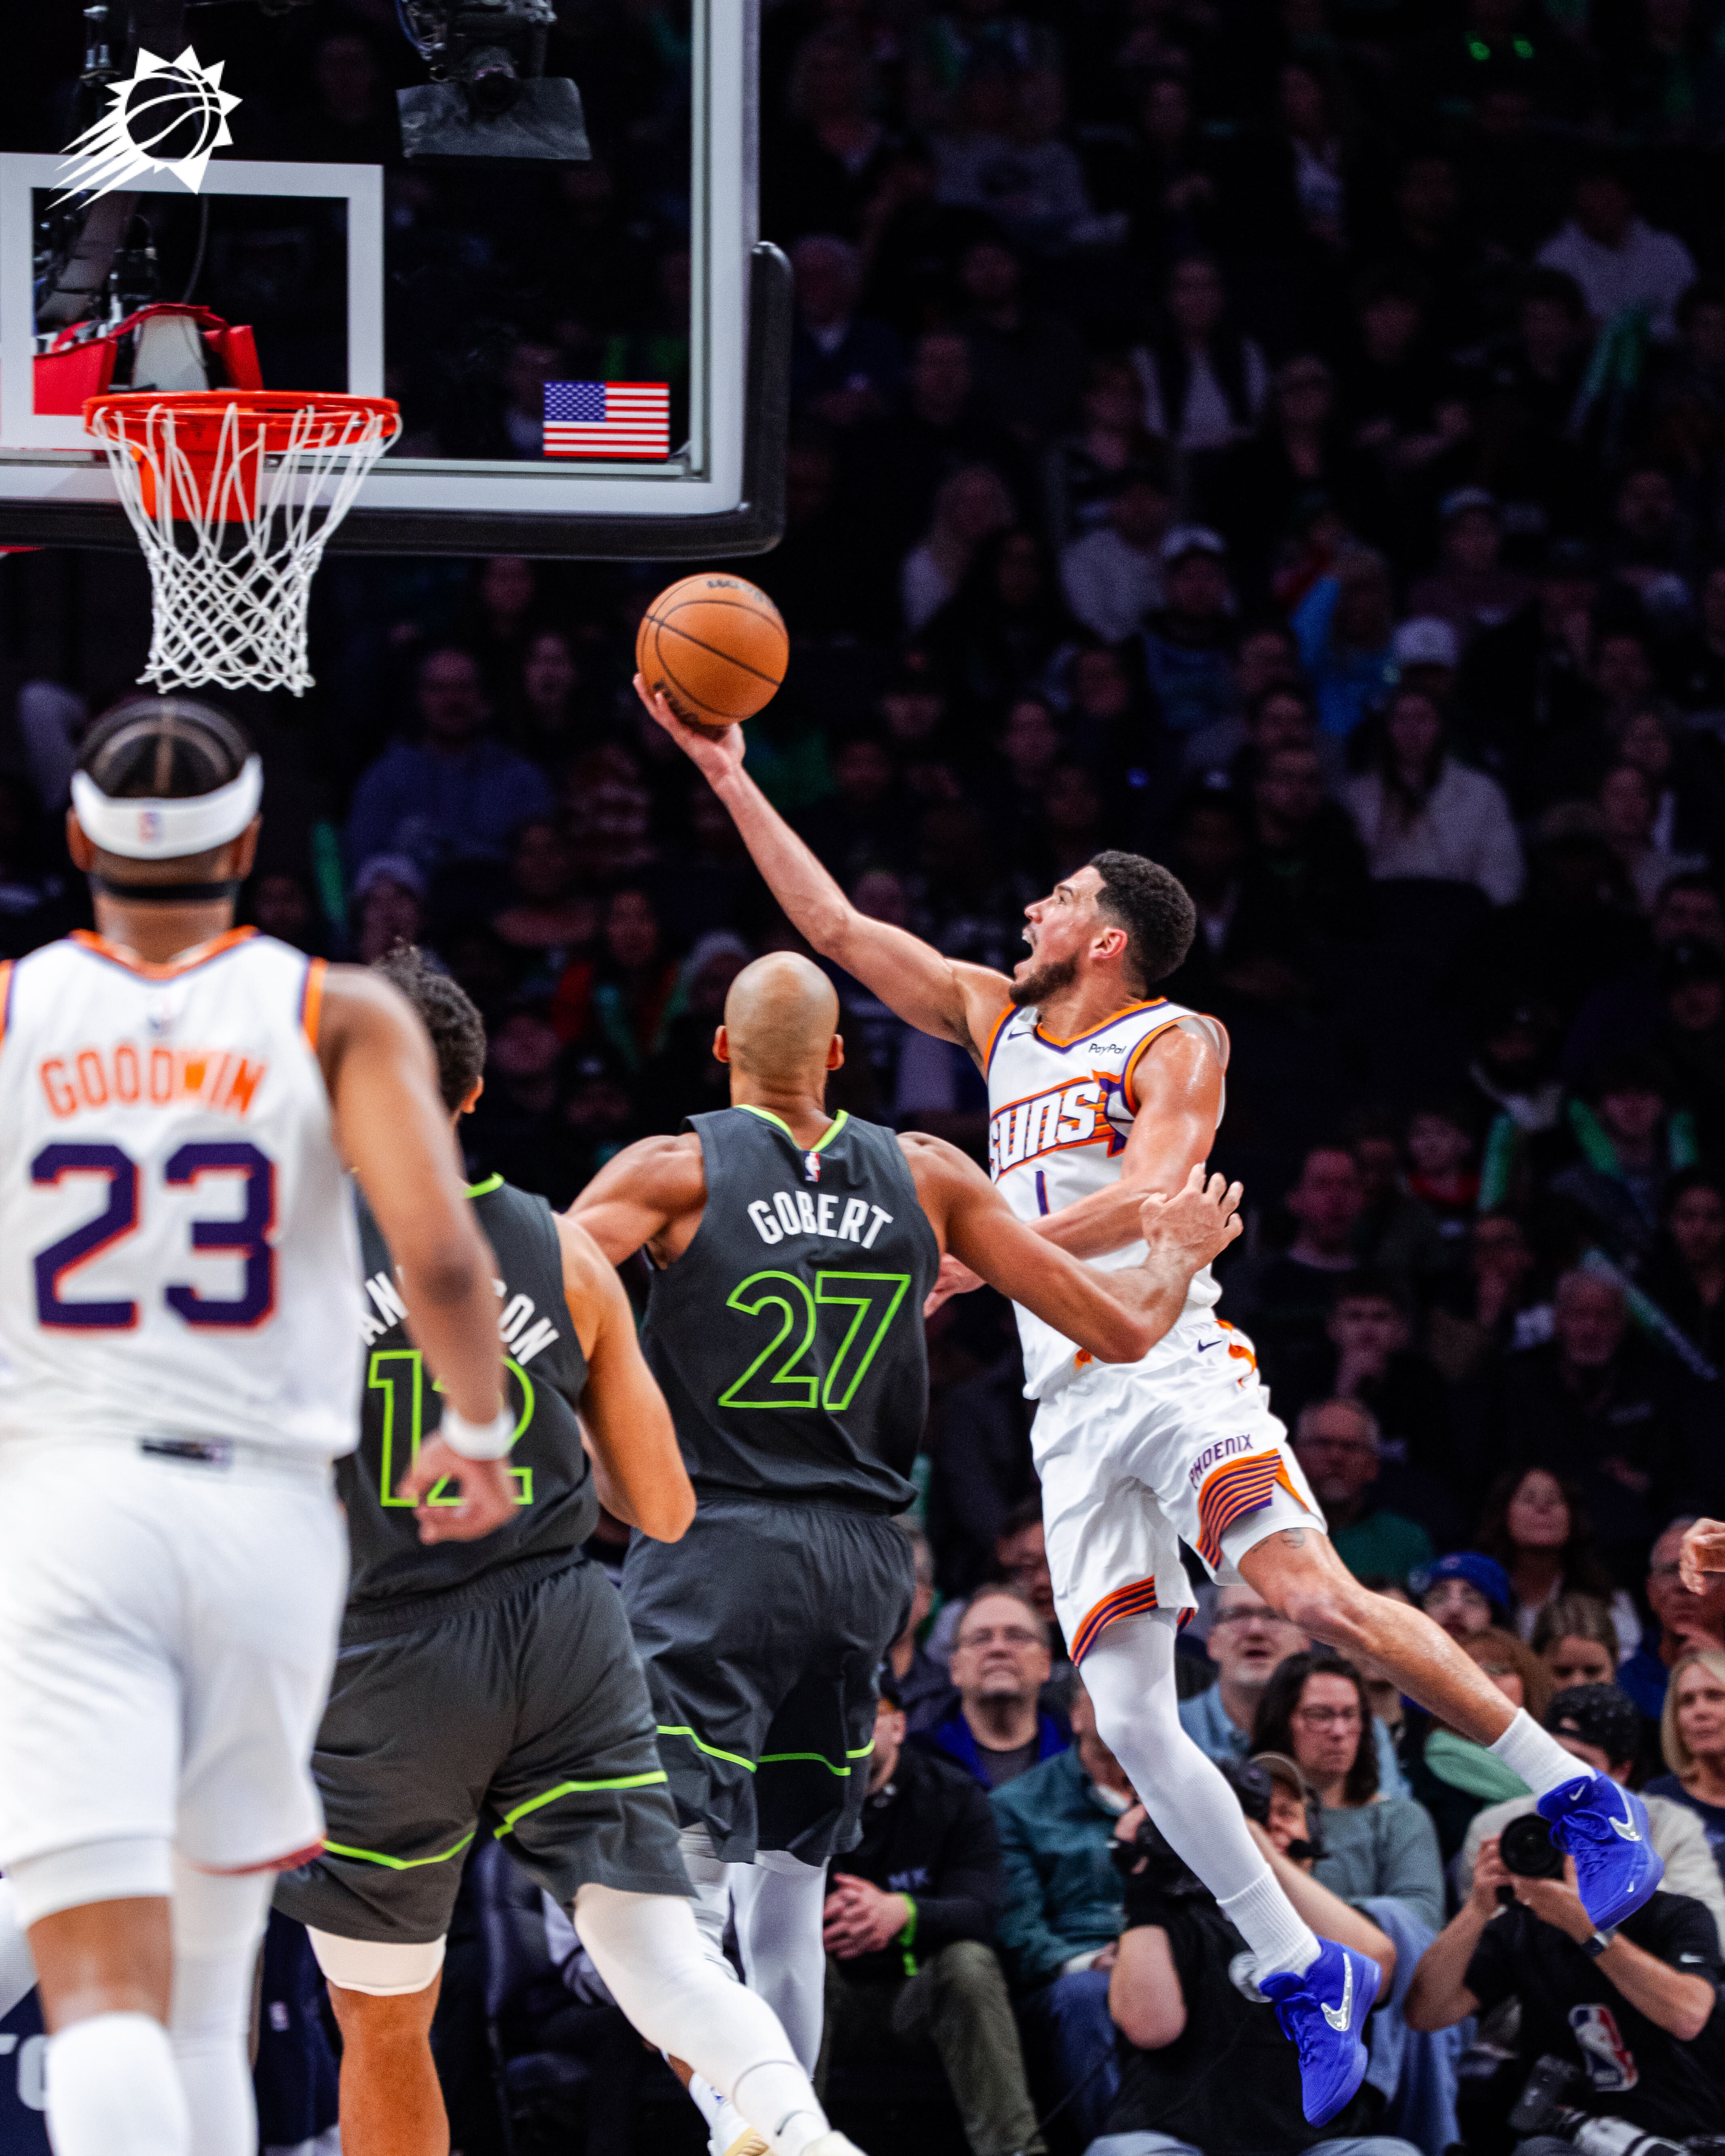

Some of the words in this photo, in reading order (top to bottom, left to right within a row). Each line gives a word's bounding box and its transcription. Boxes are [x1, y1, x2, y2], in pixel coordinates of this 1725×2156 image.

[38, 1040, 267, 1122] GOODWIN
[1088, 1043, 1127, 1056] PayPal
[989, 1080, 1101, 1184] SUNS
[747, 1191, 894, 1249] GOBERT
[1035, 1170, 1050, 1217] 1
[30, 1141, 281, 1337] 23
[718, 1270, 912, 1410] 27
[1189, 1434, 1254, 1490] PHOENIX
